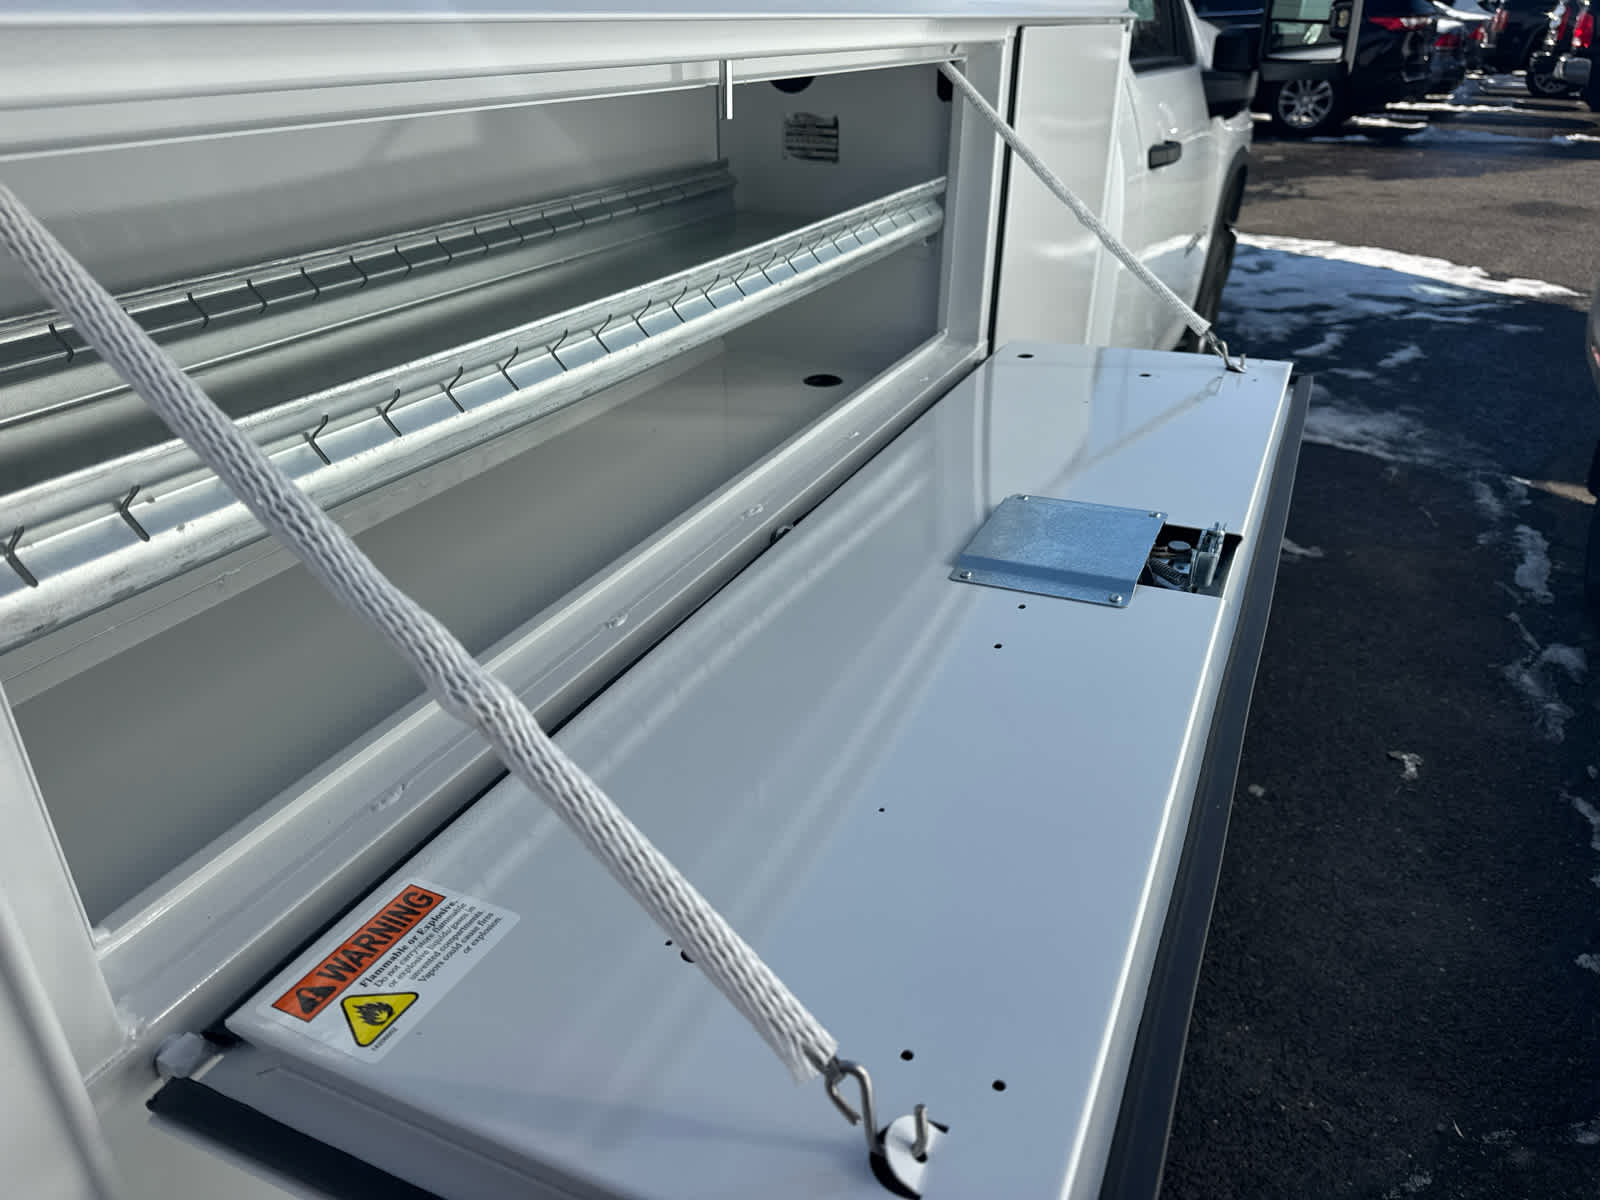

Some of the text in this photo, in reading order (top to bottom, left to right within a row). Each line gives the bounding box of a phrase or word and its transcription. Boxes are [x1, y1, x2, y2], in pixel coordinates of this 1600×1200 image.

[316, 891, 434, 982] WARNING
[358, 898, 460, 987] Flammable or Explosive.
[373, 975, 389, 987] Do
[385, 964, 401, 976] not
[430, 902, 468, 933] flammable
[407, 951, 441, 980] unvented
[417, 960, 447, 983] Vapors
[439, 942, 463, 961] could
[459, 925, 481, 943] cause
[461, 945, 473, 953] or
[386, 979, 399, 988] or
[394, 949, 431, 980] explosive
